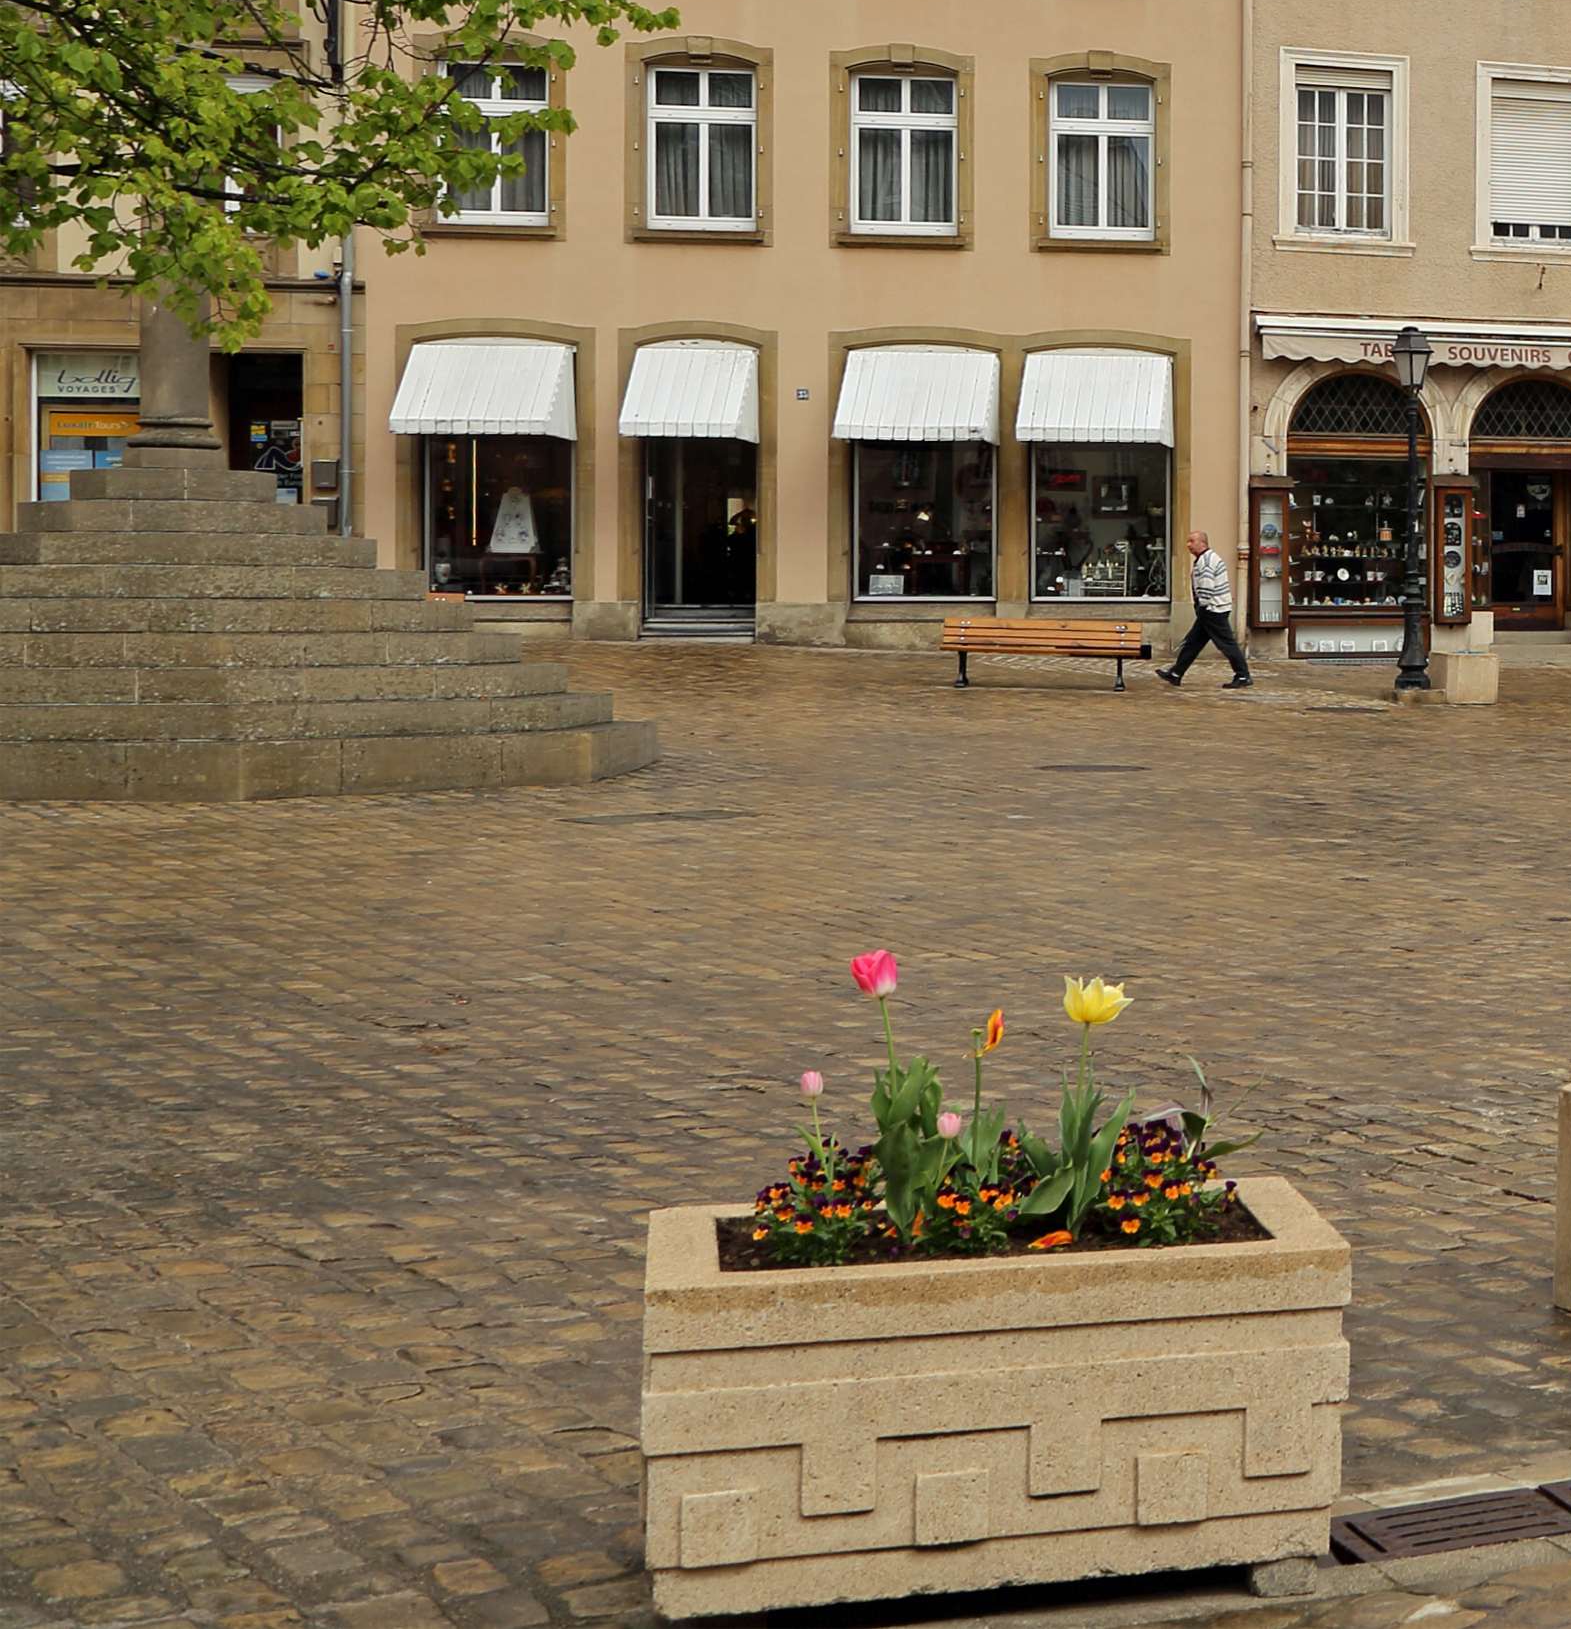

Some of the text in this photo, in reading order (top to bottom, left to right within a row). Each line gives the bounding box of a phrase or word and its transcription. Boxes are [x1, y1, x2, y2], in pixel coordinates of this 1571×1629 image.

[1447, 346, 1551, 363] SOUVENIRS
[57, 369, 136, 393] bollig
[57, 385, 116, 393] VOYAGES
